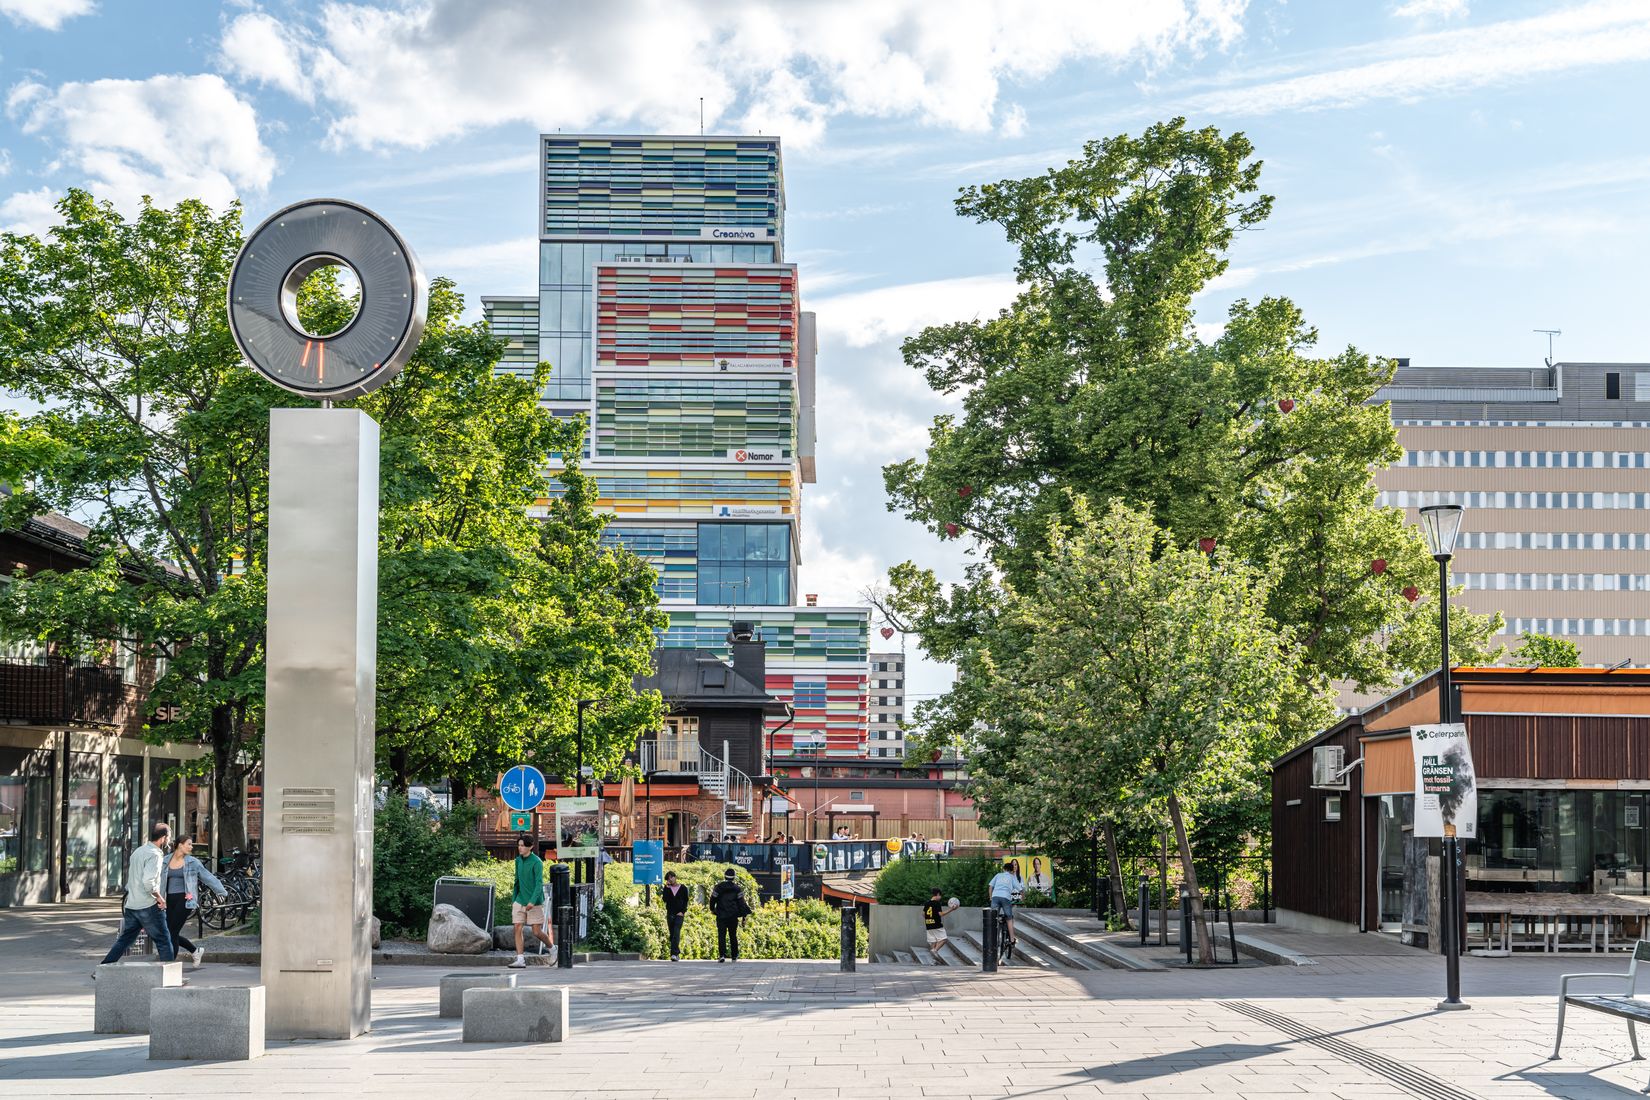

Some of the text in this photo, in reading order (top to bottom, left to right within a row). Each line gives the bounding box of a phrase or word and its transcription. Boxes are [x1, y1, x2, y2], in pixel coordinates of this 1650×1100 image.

[712, 229, 755, 238] Creanova
[748, 452, 774, 460] Nomor
[1423, 757, 1437, 766] HÅLL
[1422, 766, 1454, 775] GRÄNSEN
[926, 906, 933, 918] 4
